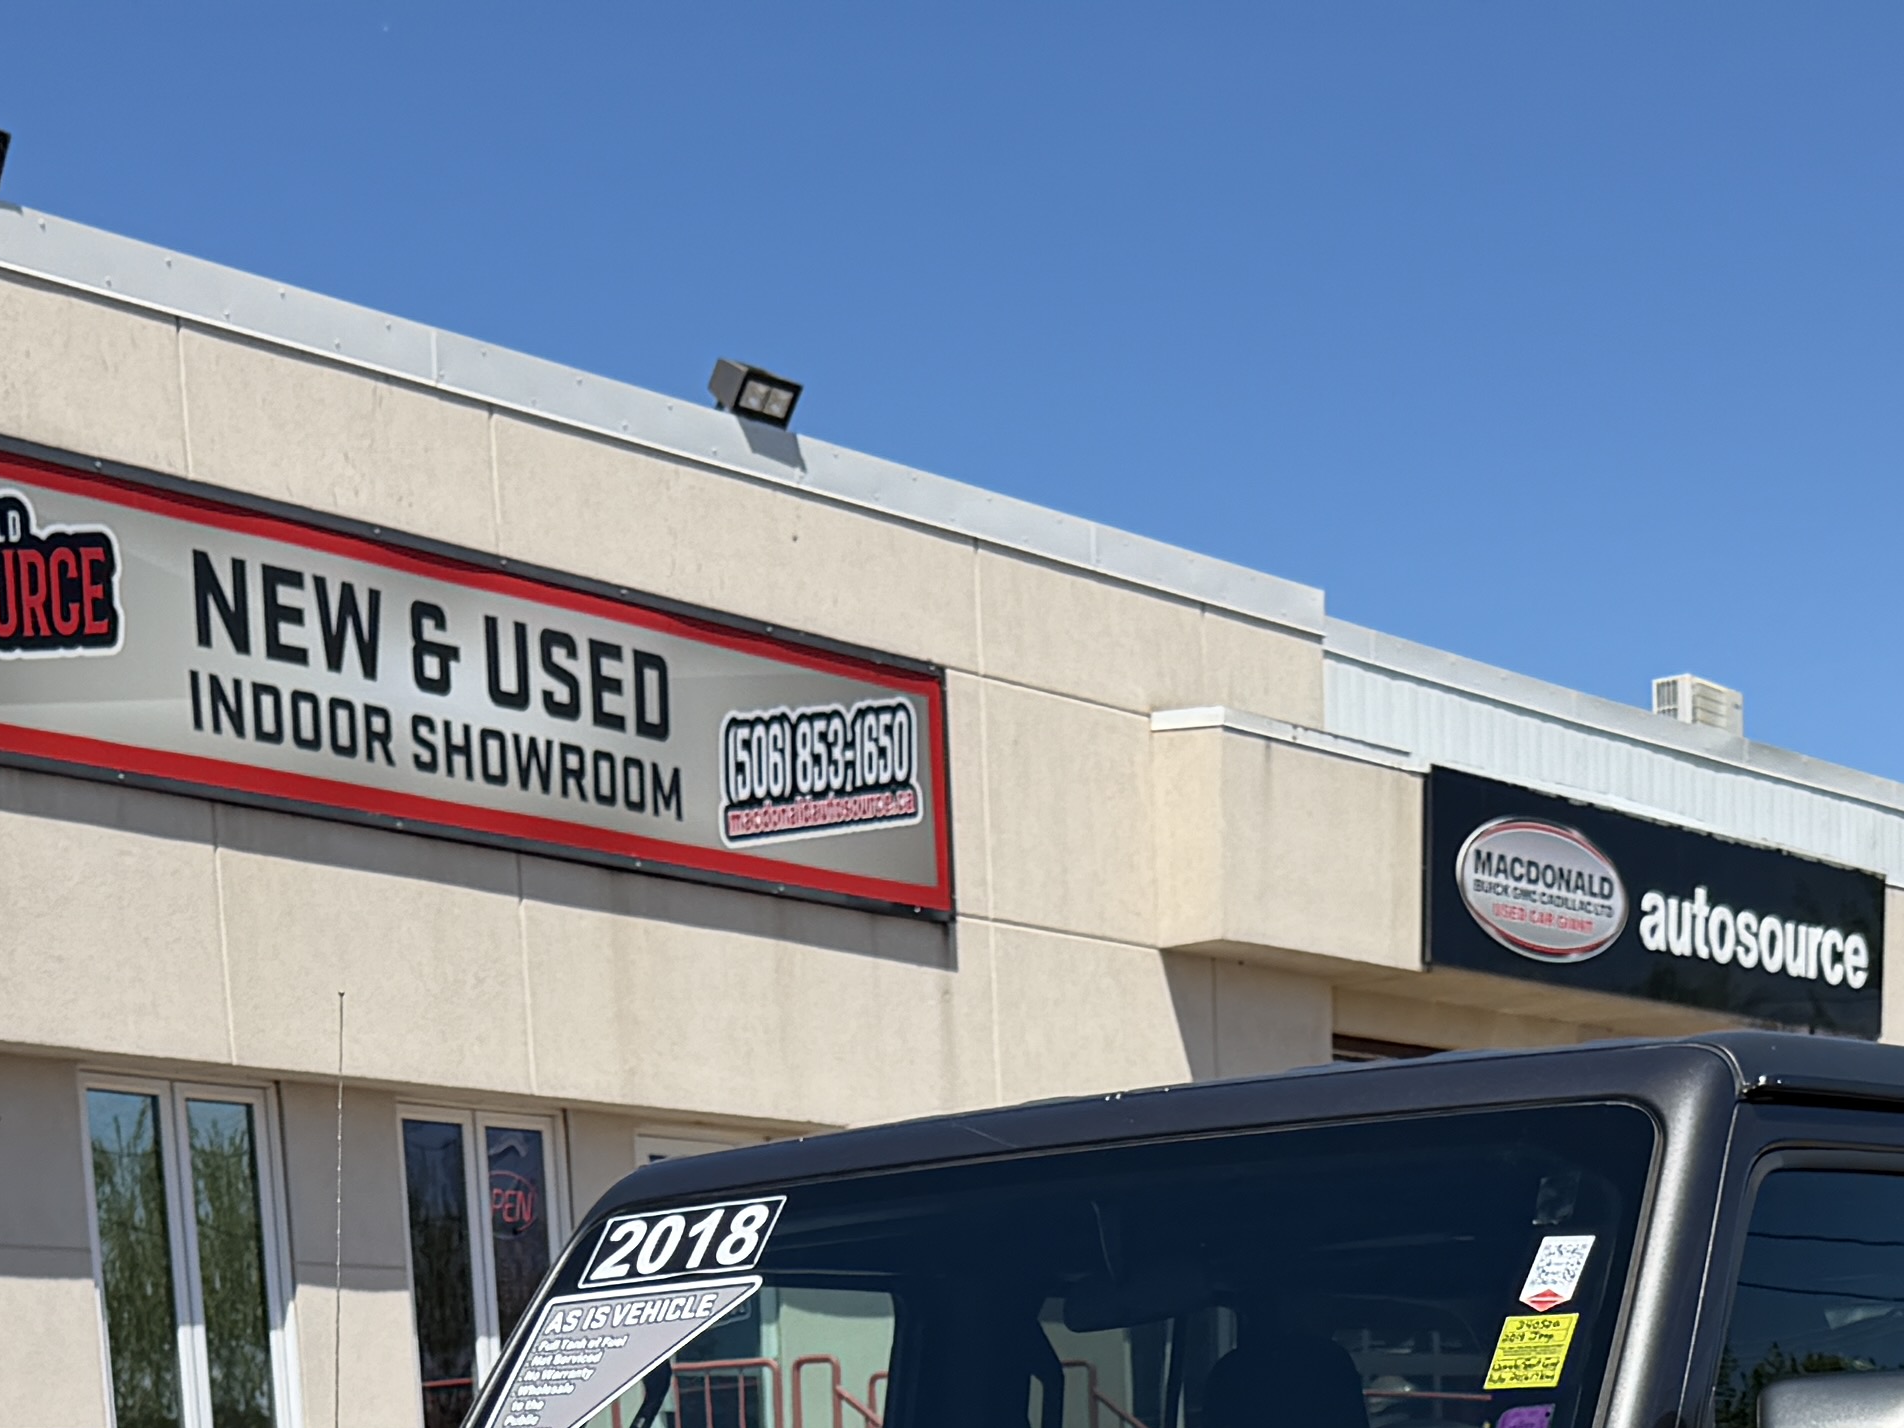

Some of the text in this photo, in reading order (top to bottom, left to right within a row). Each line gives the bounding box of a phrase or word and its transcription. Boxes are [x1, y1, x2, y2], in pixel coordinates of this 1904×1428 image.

[192, 549, 670, 741] NEW & USED
[189, 670, 683, 822] INDOOR SHOWROOM
[728, 709, 909, 804] (506) 853-1650
[1473, 879, 1510, 898] BUICK
[1474, 849, 1614, 900] MACDONALD
[1493, 903, 1526, 922] USED
[1529, 910, 1553, 926] CAR
[1639, 885, 1869, 989] autosource
[492, 1188, 533, 1223] PEN
[590, 1204, 769, 1280] 2018
[545, 1294, 718, 1335] AS IS VEHICLE
